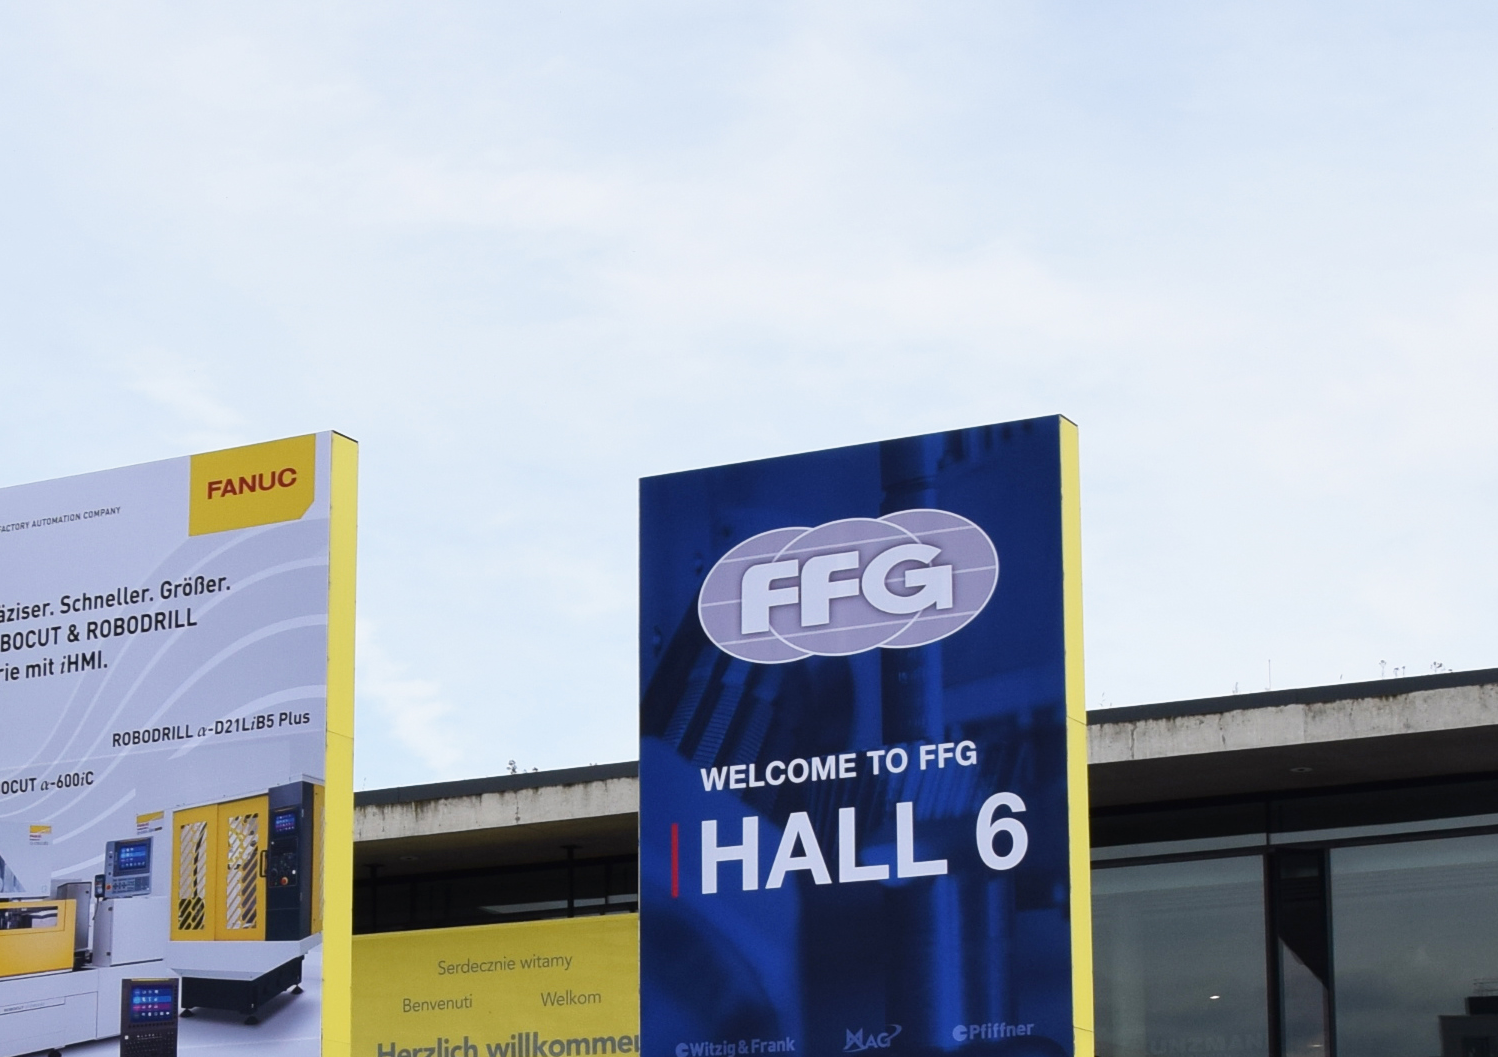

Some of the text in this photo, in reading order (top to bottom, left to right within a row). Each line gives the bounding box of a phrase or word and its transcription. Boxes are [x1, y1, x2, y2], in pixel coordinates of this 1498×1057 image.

[207, 467, 297, 500] FANUC
[31, 512, 81, 528] AUTOMATION
[83, 506, 121, 520] COMPANY
[60, 586, 155, 614] Schneller.
[160, 574, 231, 601] Größer.
[741, 543, 953, 634] FFG
[67, 624, 80, 644] &
[87, 608, 197, 639] ROBODRILL
[25, 657, 55, 680] mit
[61, 650, 109, 675] iHMI.
[112, 723, 194, 748] ROBODRILL
[278, 710, 311, 728] Plus
[701, 740, 977, 791] WELCOME TO FFG
[701, 791, 1029, 894] HALL 6
[438, 953, 573, 976] Serdecznie witamy
[403, 990, 601, 1013] Benvenuti Welkom
[969, 1022, 1035, 1040] Pfiffner
